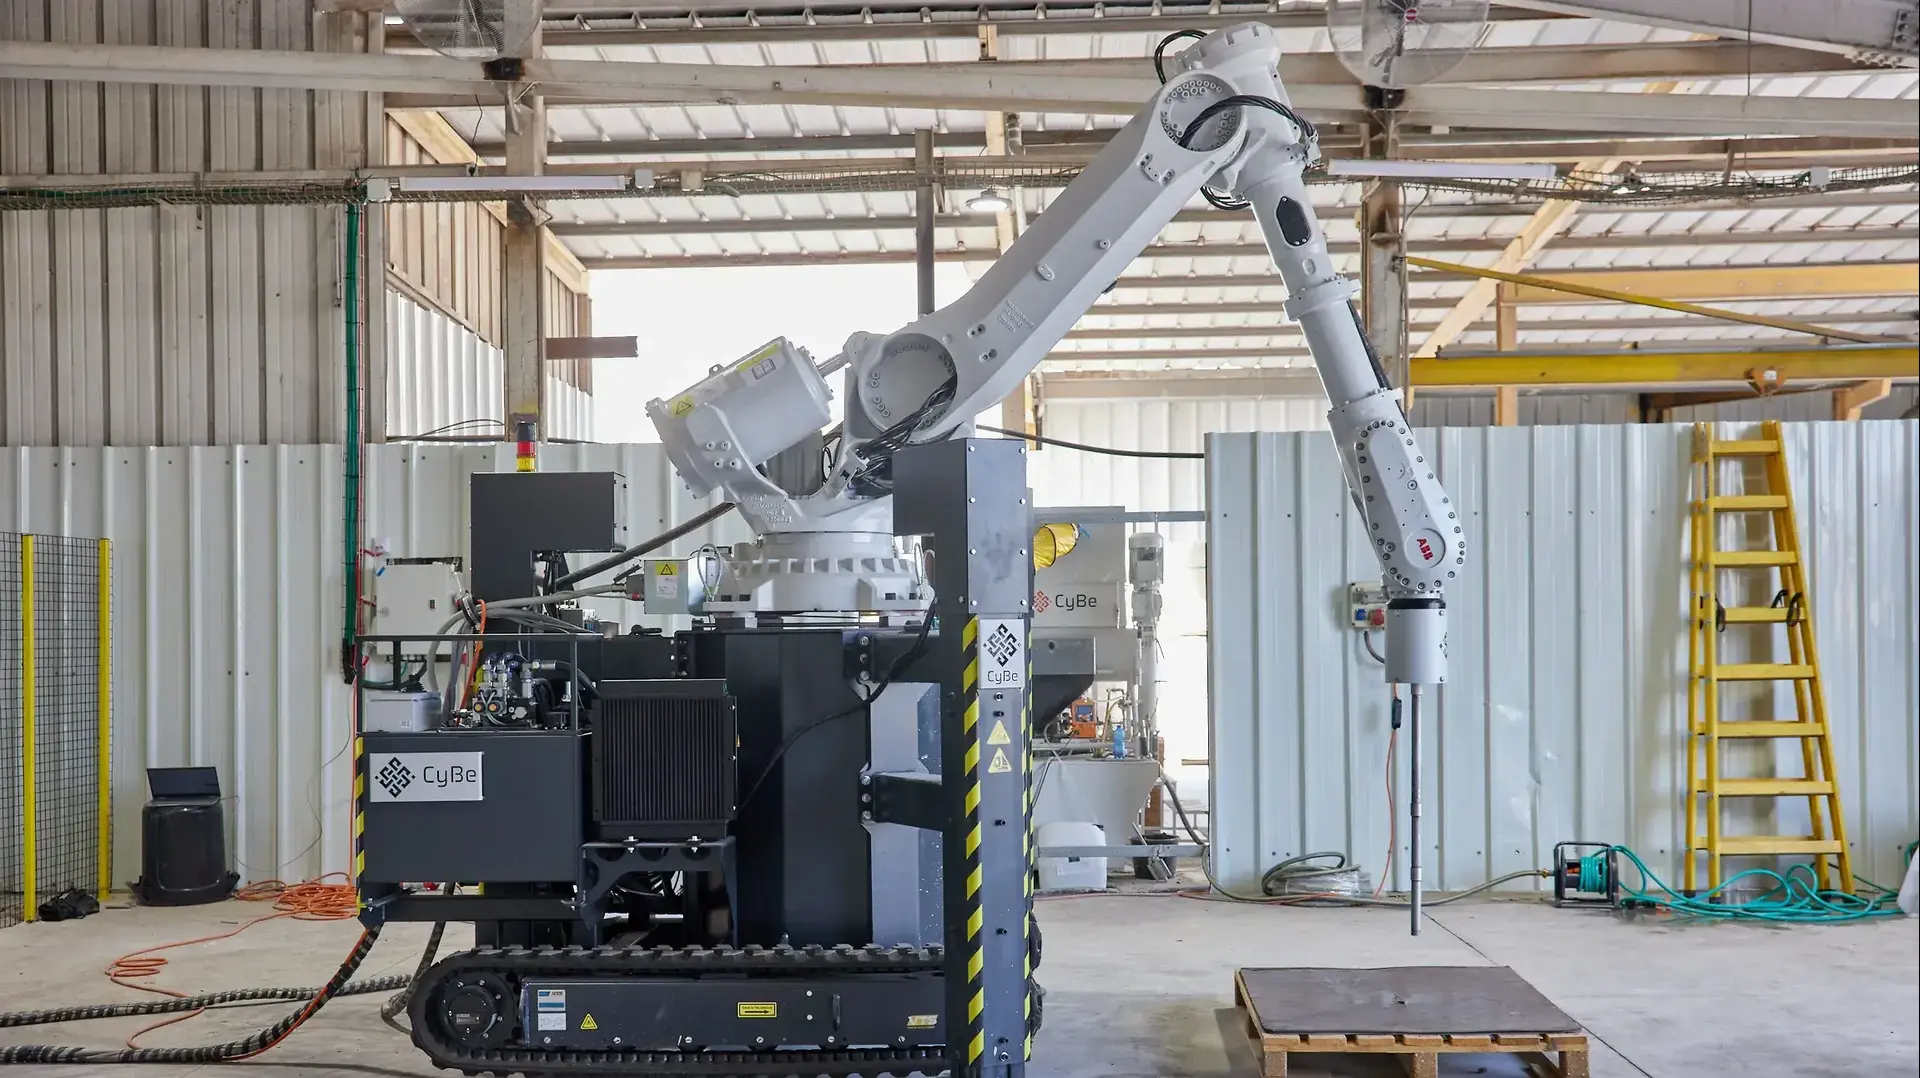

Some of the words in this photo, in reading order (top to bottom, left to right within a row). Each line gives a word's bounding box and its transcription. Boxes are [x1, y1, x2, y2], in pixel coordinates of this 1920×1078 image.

[1415, 538, 1434, 560] ABB
[1055, 594, 1097, 611] CyBe
[987, 670, 1019, 684] CyBe
[423, 766, 477, 788] CyBe
